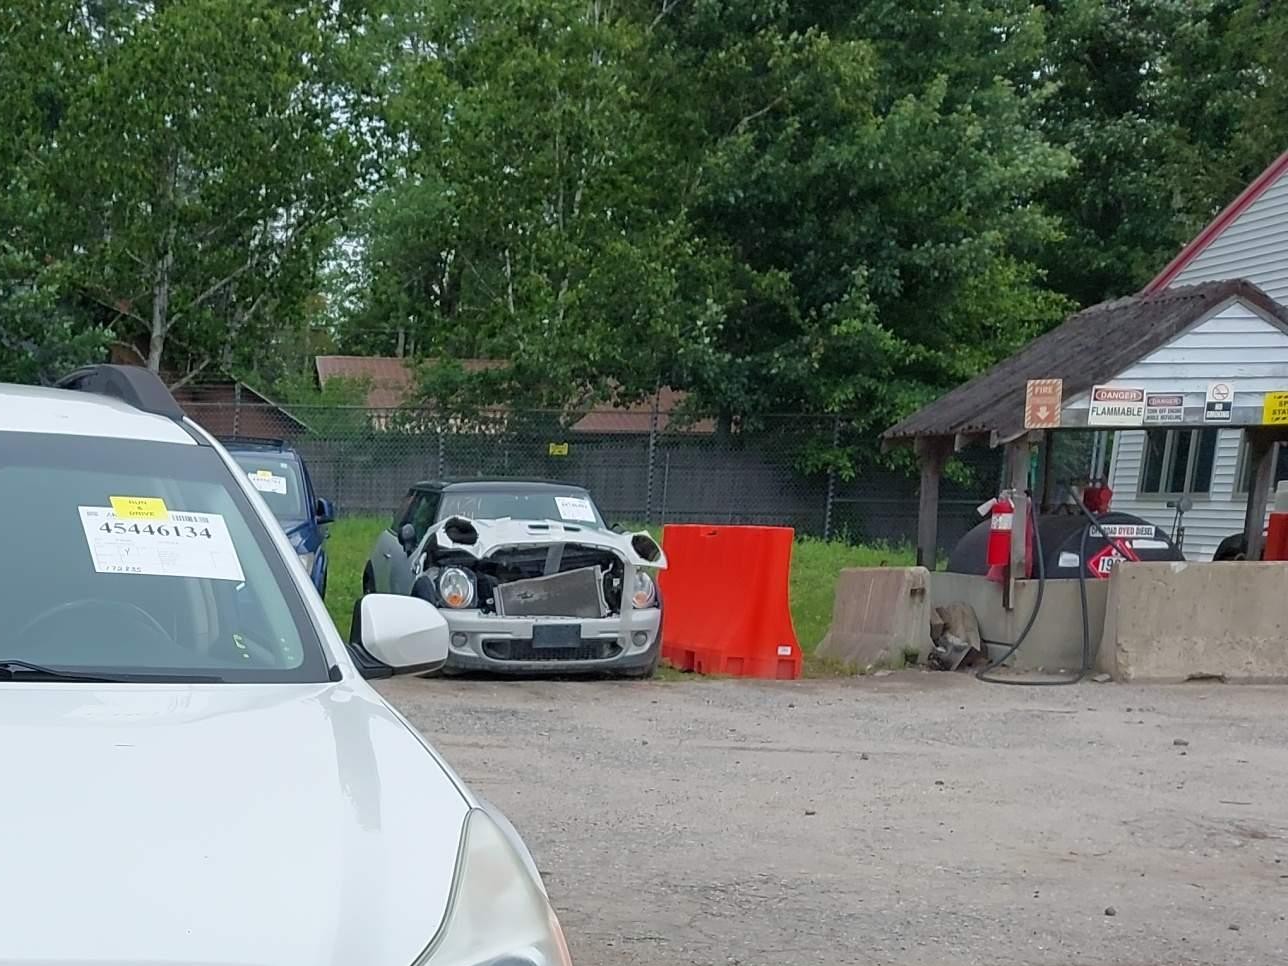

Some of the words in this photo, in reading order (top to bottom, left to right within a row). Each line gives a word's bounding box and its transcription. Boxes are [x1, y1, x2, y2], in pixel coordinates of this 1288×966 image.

[1100, 391, 1137, 400] DANGER
[1091, 406, 1143, 417] FLAMMABLE
[99, 521, 213, 539] 45446134
